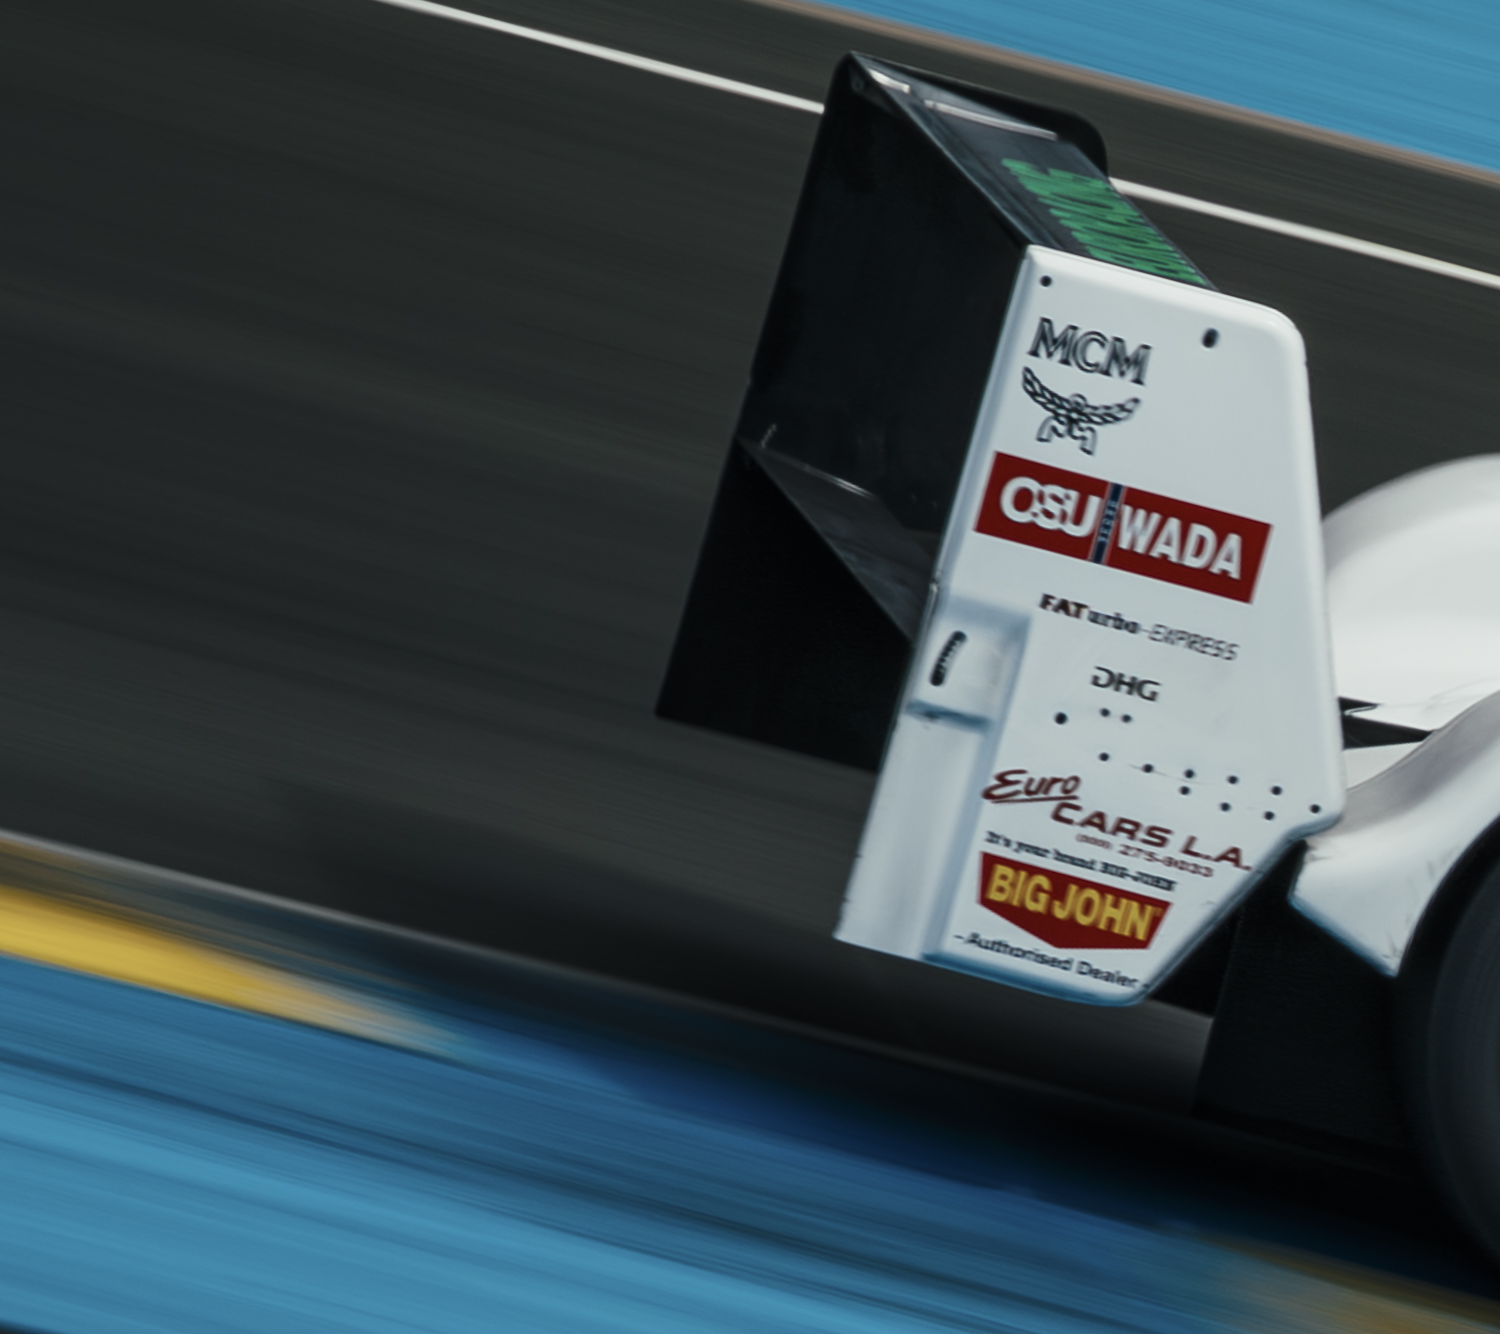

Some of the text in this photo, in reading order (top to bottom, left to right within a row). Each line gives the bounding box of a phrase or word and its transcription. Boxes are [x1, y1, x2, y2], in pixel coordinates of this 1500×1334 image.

[1026, 316, 1152, 386] MCM
[1118, 504, 1243, 580] WADA
[1091, 666, 1162, 702] DHG
[981, 769, 1081, 801] Euro
[1051, 802, 1251, 871] CARS L.A.
[985, 863, 1157, 941] BIG JOHN
[1077, 960, 1139, 989] Dealer
